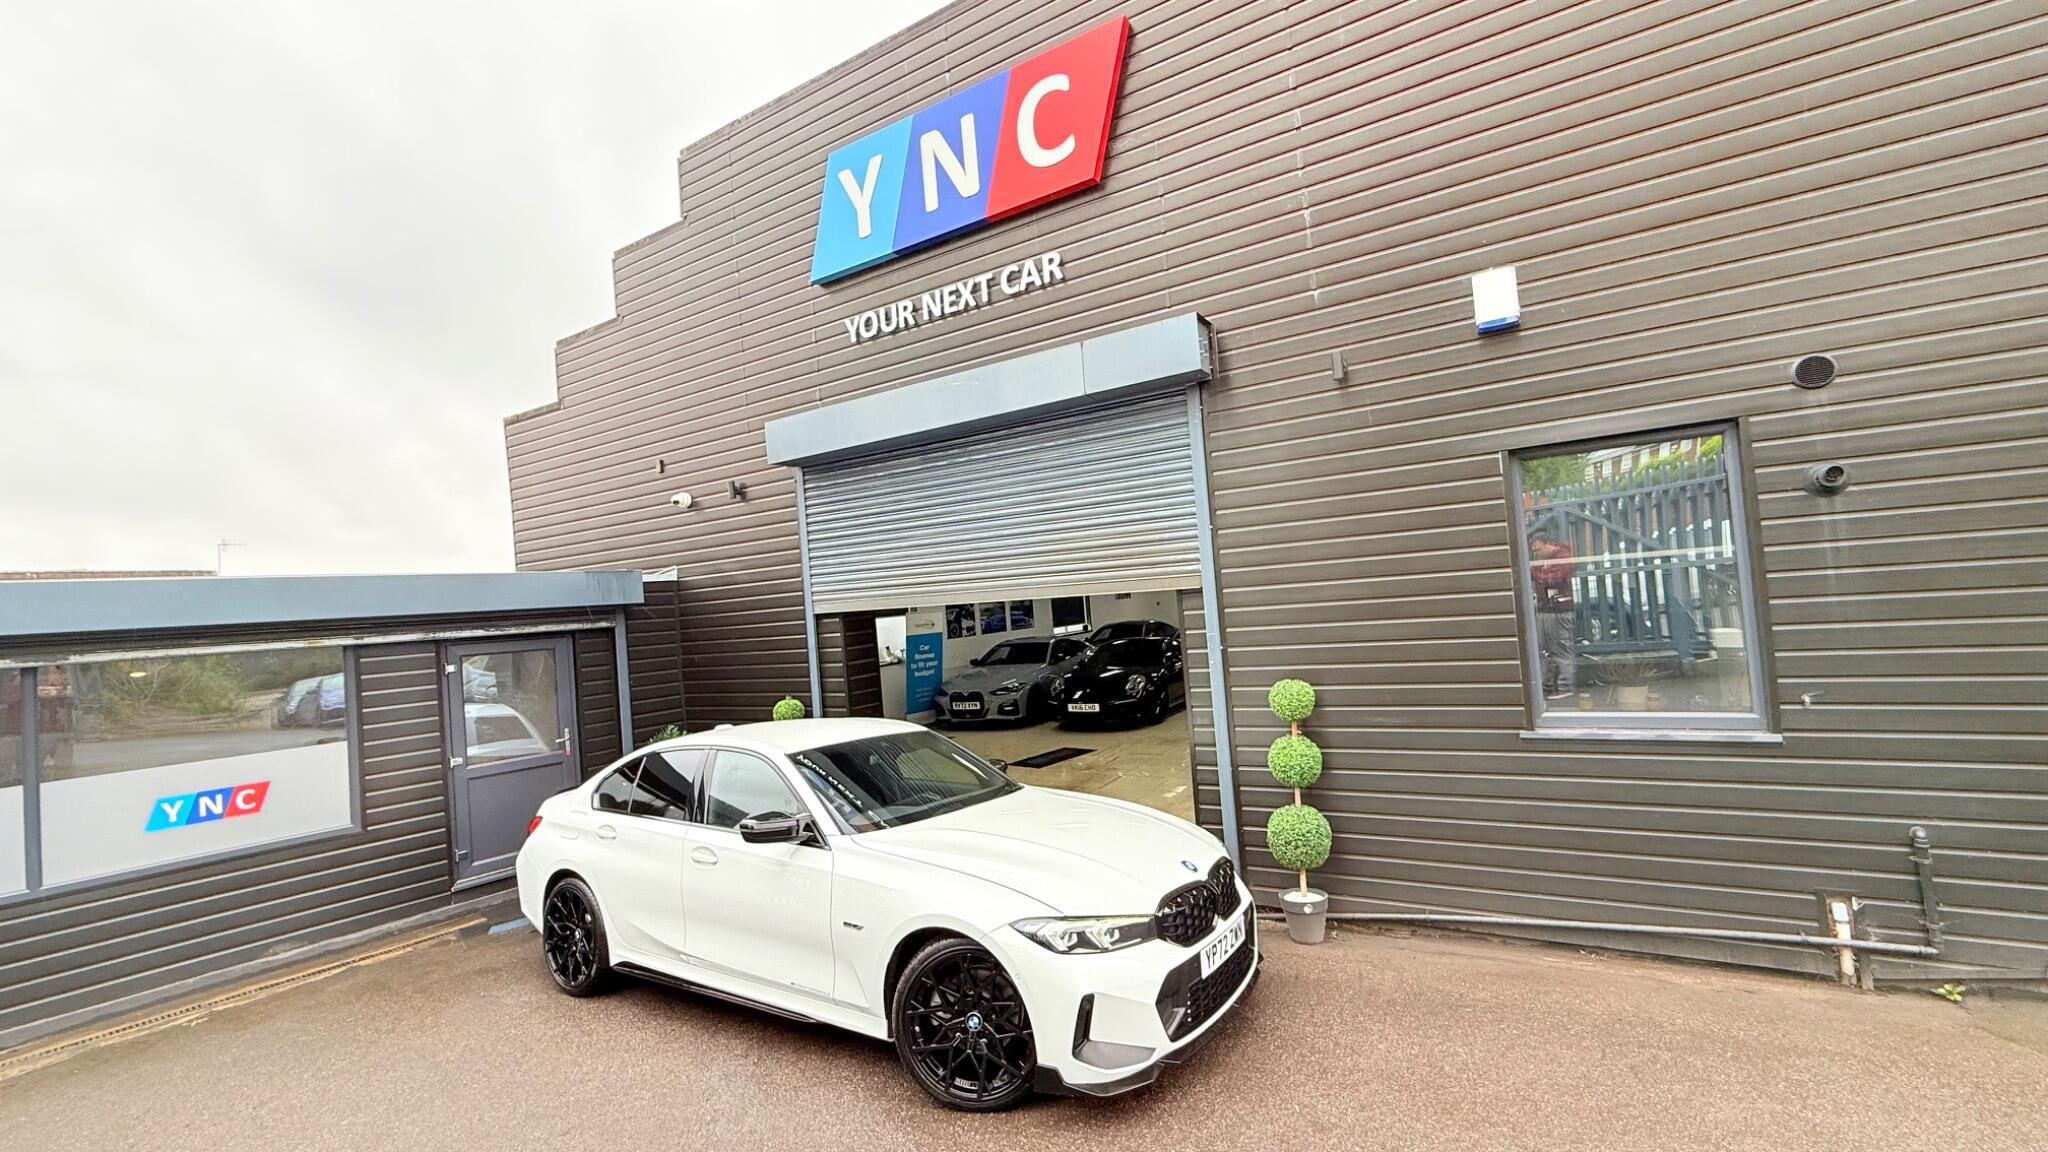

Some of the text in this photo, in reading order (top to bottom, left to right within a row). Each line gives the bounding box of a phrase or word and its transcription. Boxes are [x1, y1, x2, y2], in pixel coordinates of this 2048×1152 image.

[837, 73, 1076, 239] YNC
[844, 250, 1064, 343] YOUR NEXT CAR
[914, 668, 935, 677] budget
[925, 660, 938, 669] your
[161, 788, 257, 823] YNC
[1205, 933, 1229, 970] YP72
